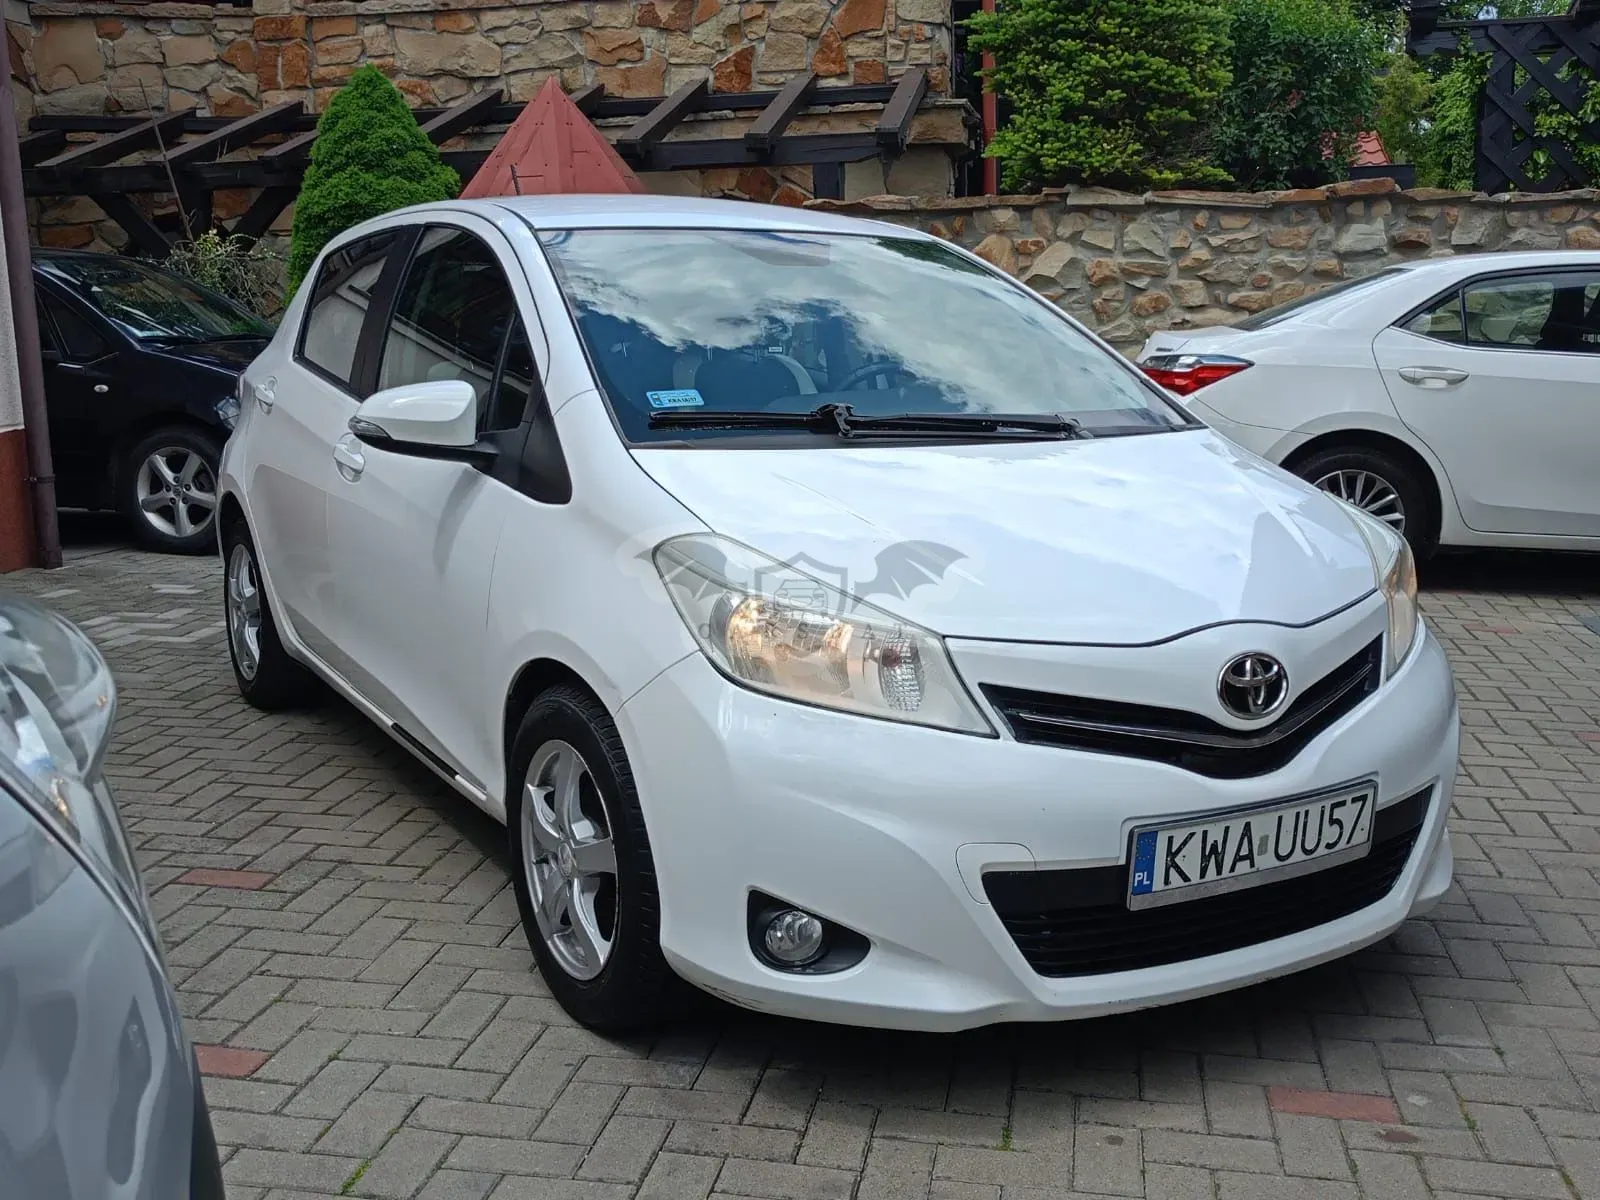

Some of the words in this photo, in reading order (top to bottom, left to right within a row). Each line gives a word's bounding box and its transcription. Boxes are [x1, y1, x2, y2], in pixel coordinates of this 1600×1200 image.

[1163, 821, 1256, 886] KWA
[1273, 793, 1370, 863] UU57
[1133, 872, 1151, 888] PL
